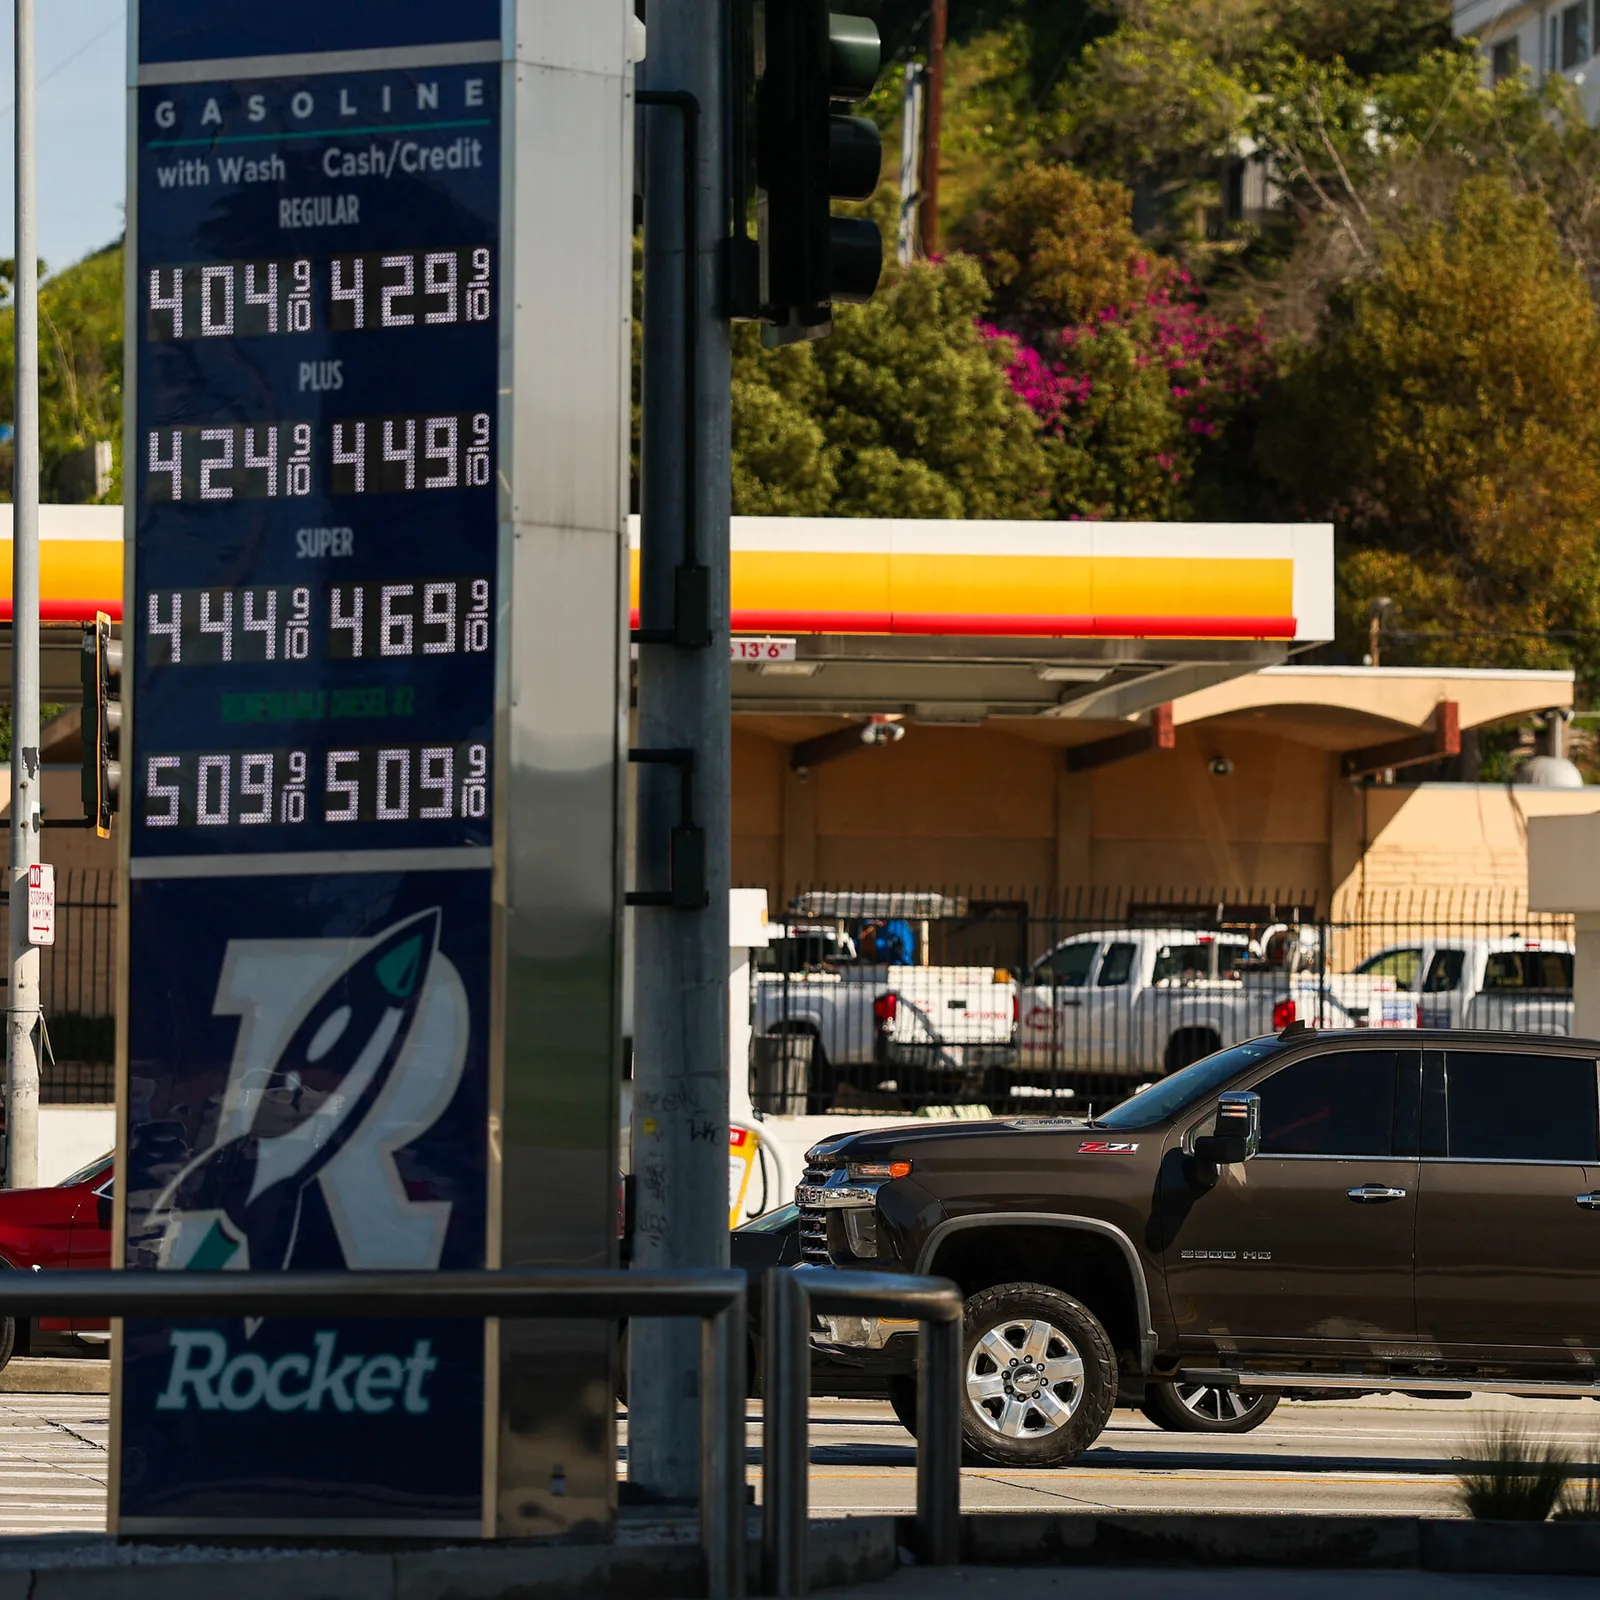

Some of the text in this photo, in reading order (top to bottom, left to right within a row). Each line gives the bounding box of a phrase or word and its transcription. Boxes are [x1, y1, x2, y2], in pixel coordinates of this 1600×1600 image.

[154, 79, 484, 128] GASOLINE
[157, 154, 286, 188] with Wash
[322, 137, 482, 179] Cash/Credit
[279, 195, 360, 229] REGULAR
[149, 263, 278, 338] 404
[331, 252, 458, 329] 429
[299, 361, 343, 391] PLUS
[148, 426, 278, 500] 424
[332, 416, 458, 492] 449
[296, 527, 354, 559] SUPER
[148, 589, 277, 663] 444
[330, 582, 457, 657] 469
[146, 753, 274, 827] 509
[325, 747, 454, 822] 509
[30, 867, 41, 886] NO
[30, 890, 53, 907] STOPPING
[1077, 1141, 1139, 1154] Z71
[156, 1330, 438, 1413] Rocket
